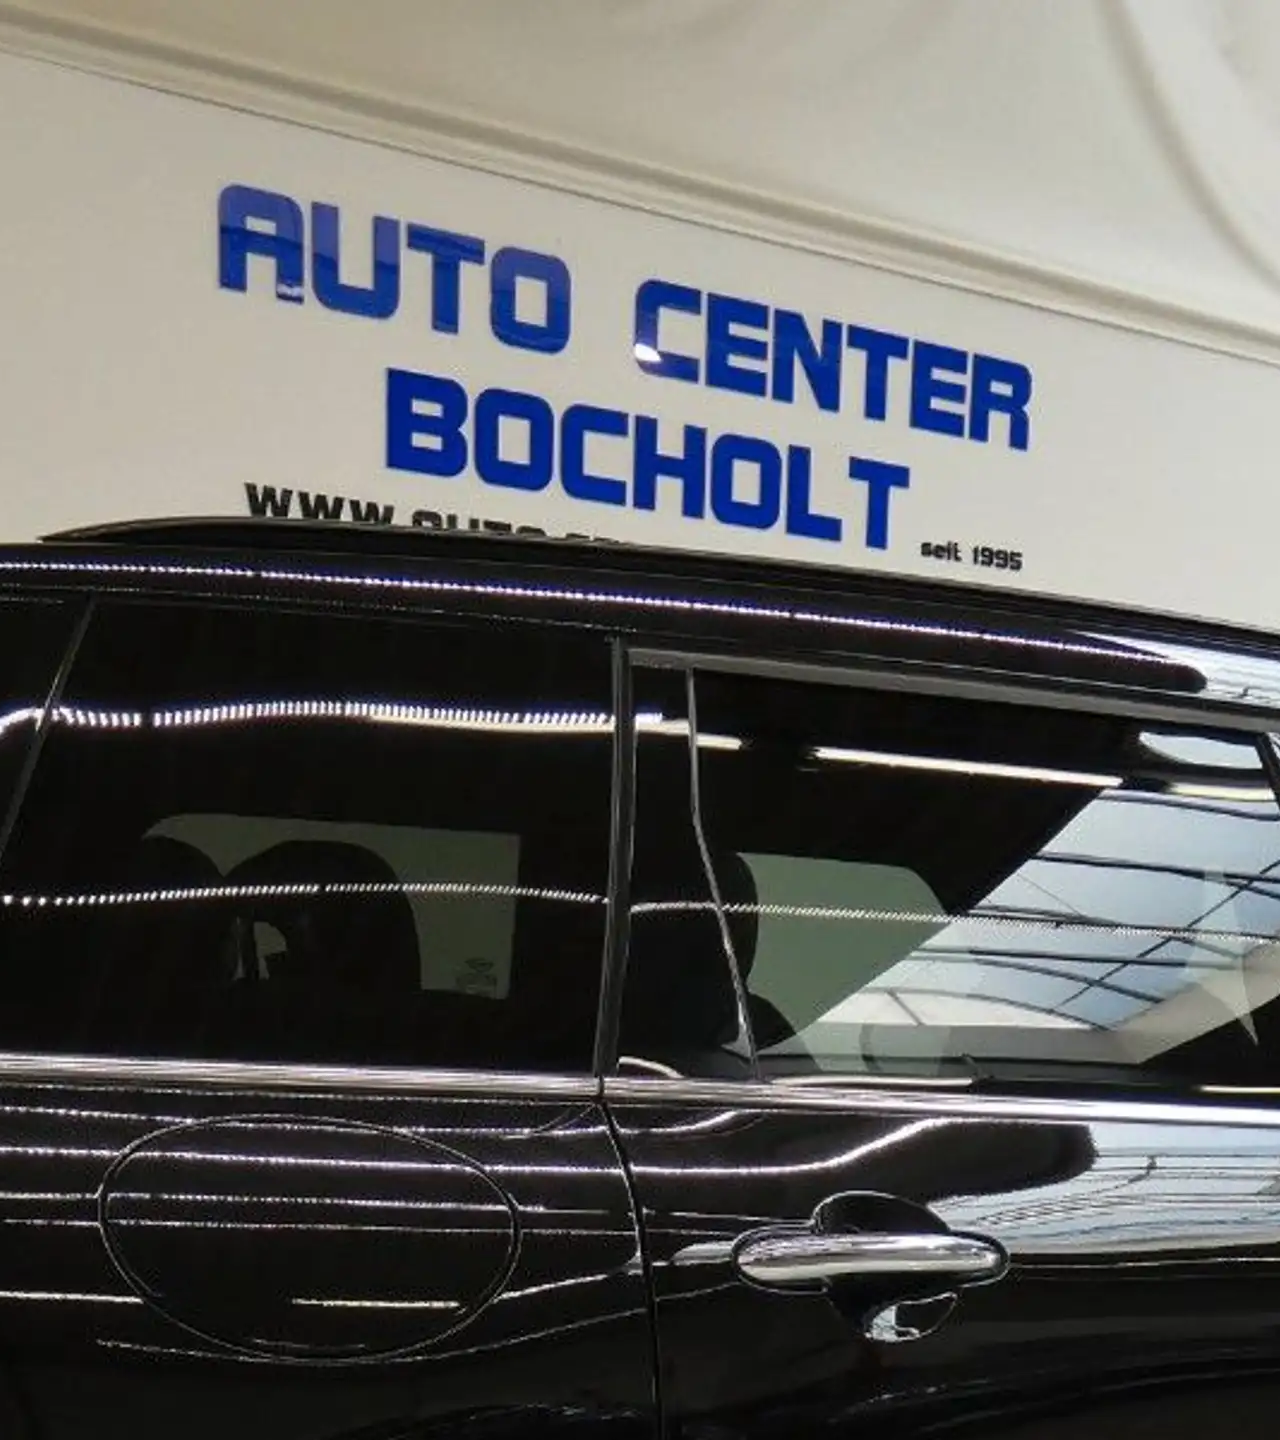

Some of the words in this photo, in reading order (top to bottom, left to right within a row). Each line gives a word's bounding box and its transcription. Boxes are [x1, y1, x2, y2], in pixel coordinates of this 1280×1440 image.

[218, 184, 572, 355] AUTO
[634, 279, 1033, 452] CENTER
[387, 367, 910, 551] BOCHOLT
[972, 545, 1024, 572] 1995
